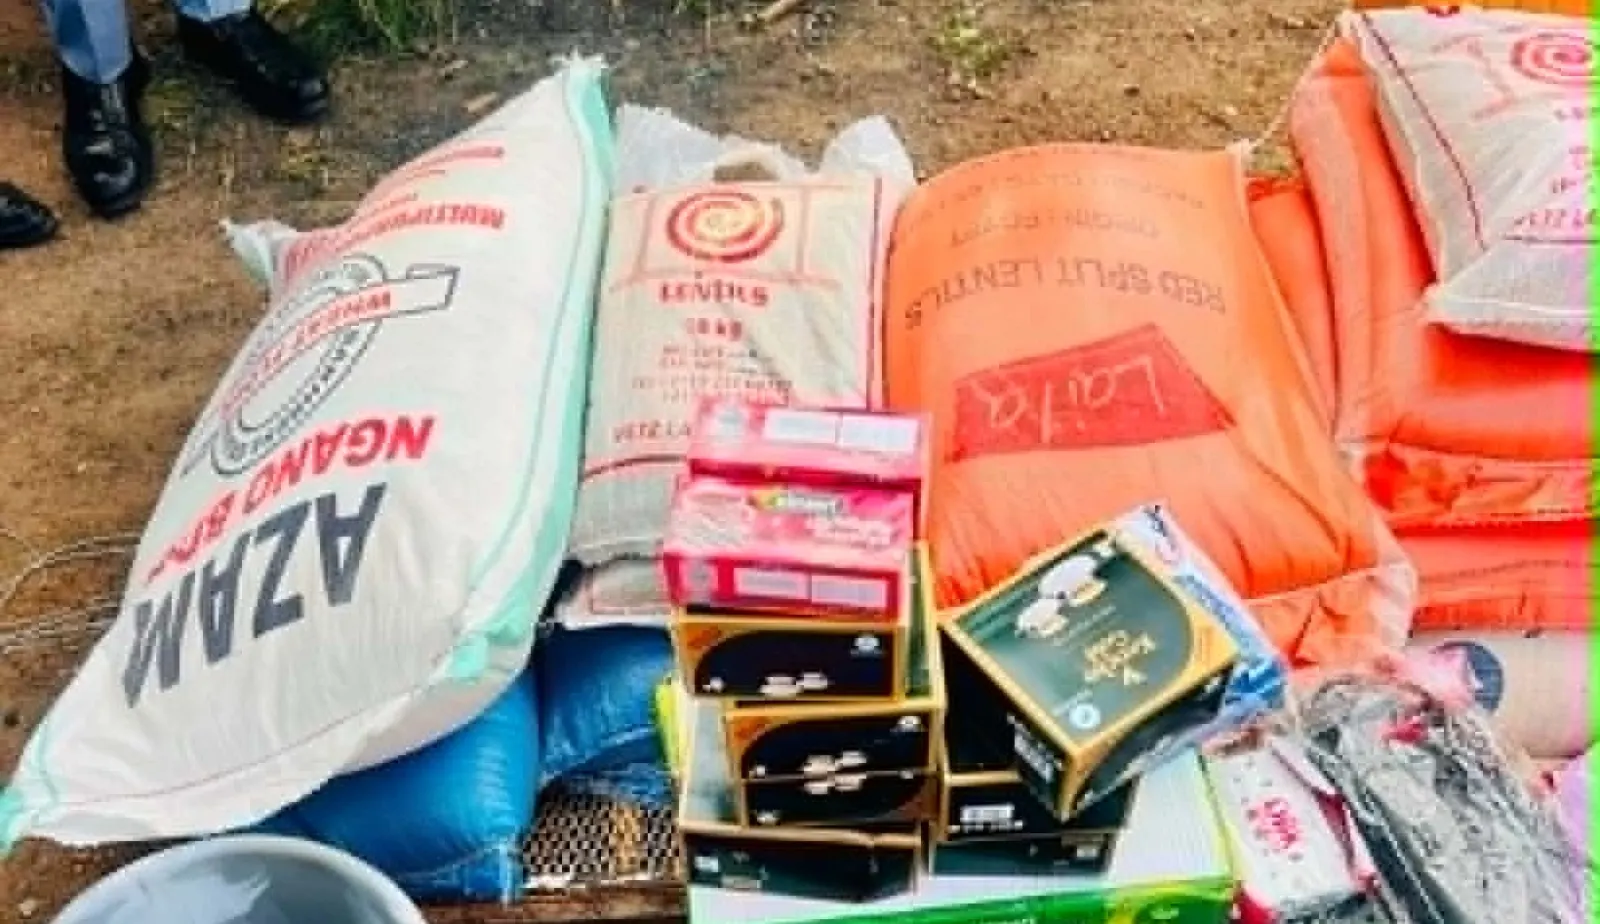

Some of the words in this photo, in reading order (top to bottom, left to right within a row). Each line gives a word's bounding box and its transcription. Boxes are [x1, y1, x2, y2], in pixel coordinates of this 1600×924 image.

[904, 257, 1044, 331] LENTILS
[1058, 257, 1153, 295] SPLIT
[1158, 271, 1227, 316] RED
[243, 415, 435, 514] NGANO
[122, 482, 387, 708] AZAM
